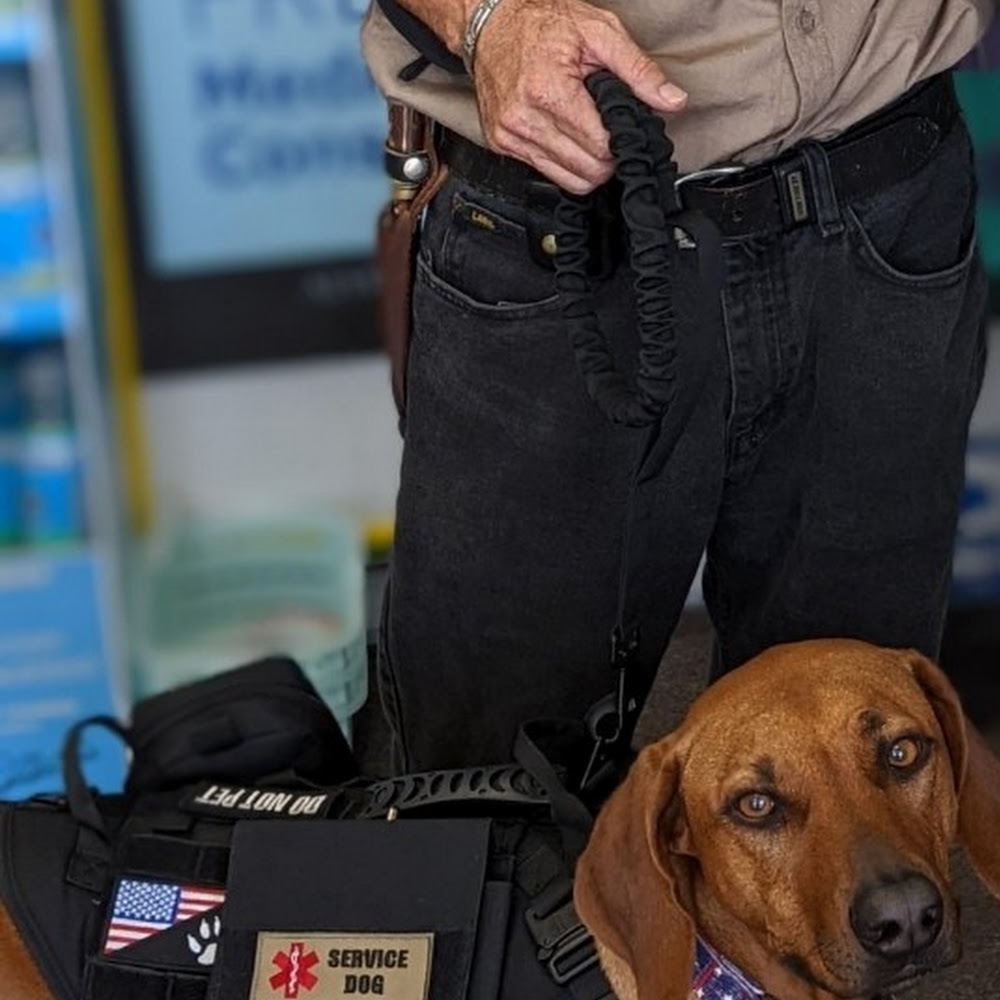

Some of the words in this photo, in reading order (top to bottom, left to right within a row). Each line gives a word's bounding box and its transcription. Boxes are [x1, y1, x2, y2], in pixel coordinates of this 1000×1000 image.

[194, 785, 246, 808] PET
[238, 790, 293, 812] NOT
[288, 794, 327, 815] DO
[327, 949, 409, 969] SERVICE
[343, 975, 384, 995] DOG
